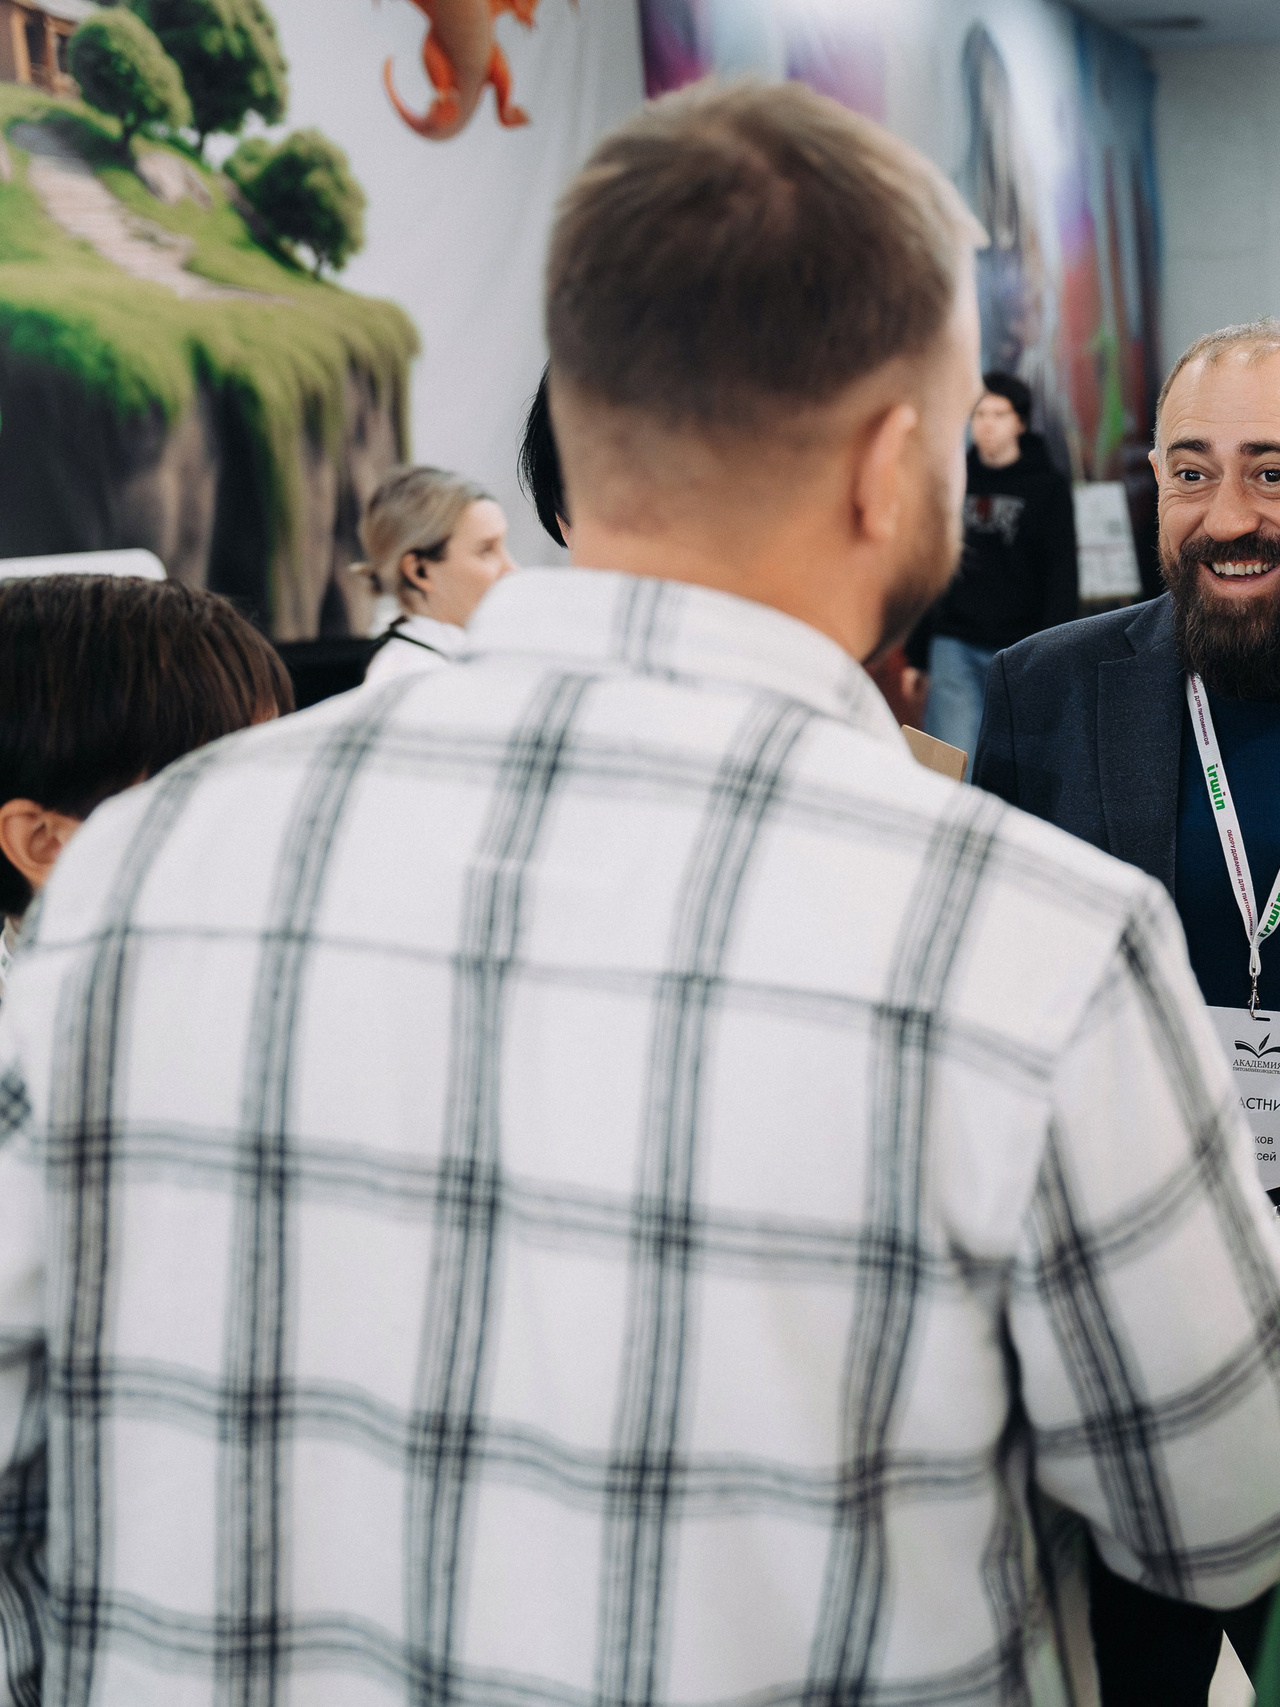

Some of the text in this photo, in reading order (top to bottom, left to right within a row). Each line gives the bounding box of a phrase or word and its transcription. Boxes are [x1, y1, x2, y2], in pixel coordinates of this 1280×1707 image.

[1194, 695, 1202, 708] ДЛЯ
[1198, 708, 1210, 746] ПИТОМНИКОВ
[1206, 763, 1226, 810] irwin
[1227, 829, 1242, 877] ОБОРУДОВАНИЕ
[1238, 878, 1246, 892] ДЛЯ
[1253, 1136, 1274, 1145] ков
[1254, 1151, 1277, 1162] сей
